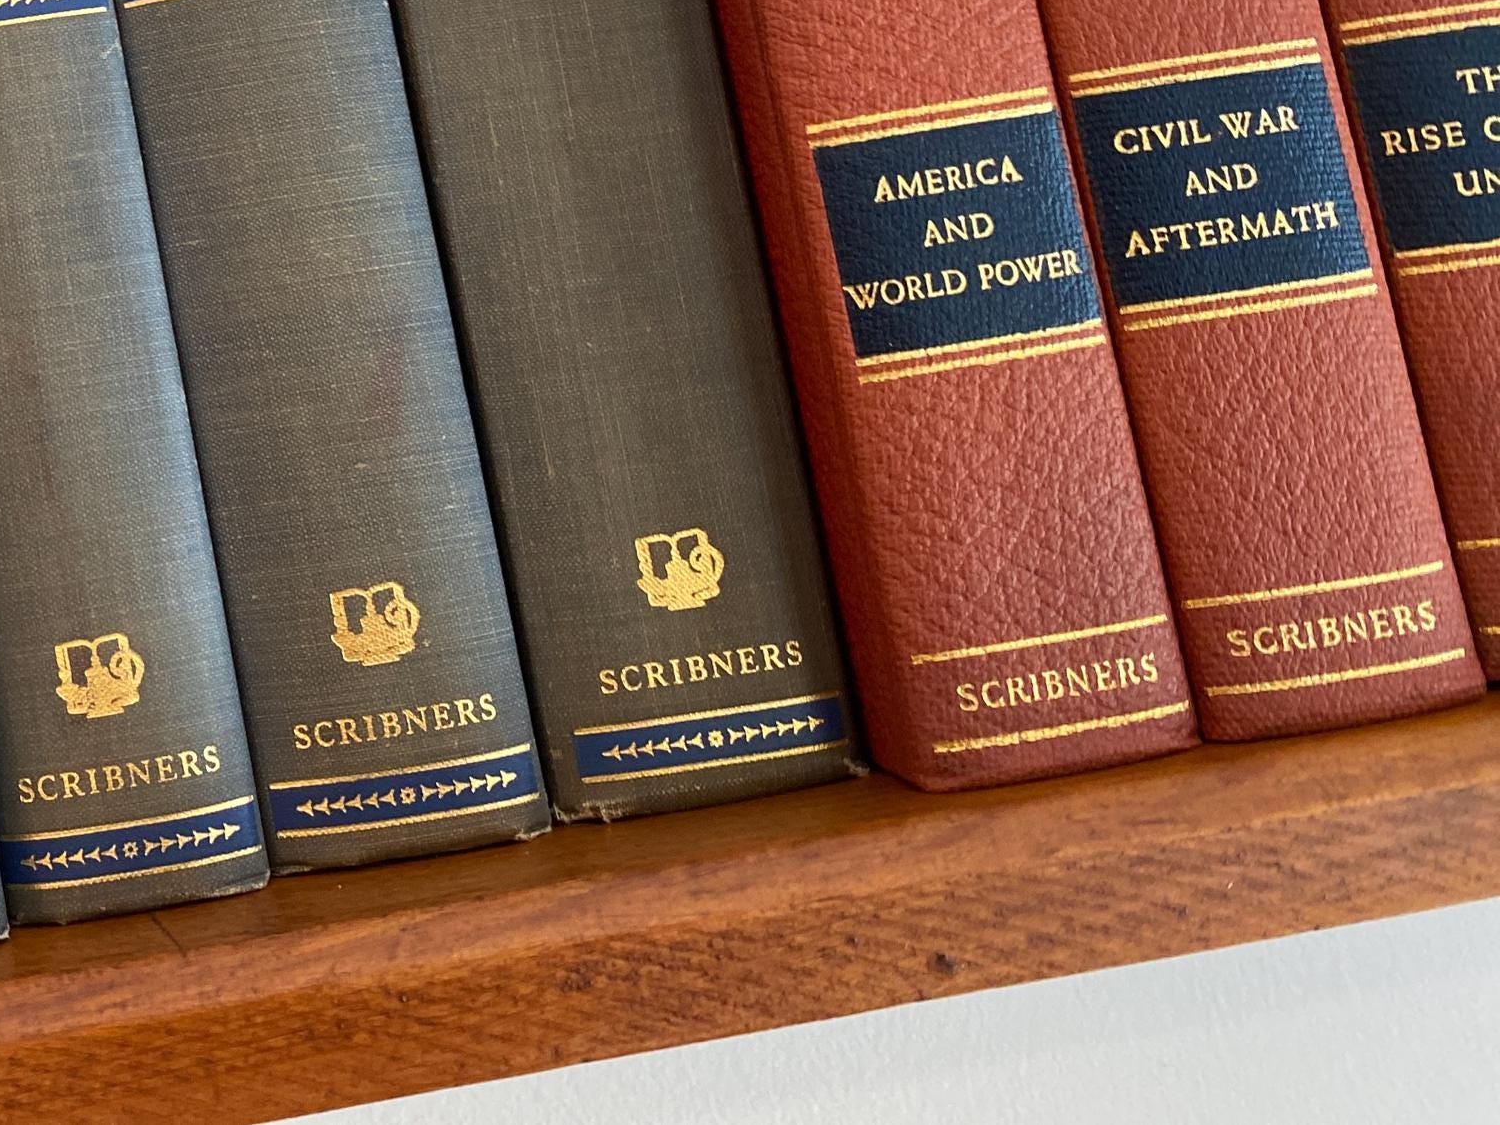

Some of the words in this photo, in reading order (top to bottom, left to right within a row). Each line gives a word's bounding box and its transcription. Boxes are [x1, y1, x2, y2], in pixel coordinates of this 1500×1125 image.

[1113, 118, 1212, 155] CIVIL
[1218, 105, 1300, 139] WAR
[1380, 120, 1467, 156] RISE
[873, 154, 1024, 203] AMERICA
[1185, 163, 1259, 197] AND
[923, 212, 995, 248] AND
[1125, 200, 1341, 259] AFTERMATH
[842, 269, 967, 310] WORLD
[977, 249, 1084, 291] POWER
[1226, 597, 1437, 657] SCRIBNERS
[599, 640, 803, 695] SCRIBNERS
[956, 651, 1159, 712] SCRIBNERS
[293, 692, 497, 750] SCRIBNERS
[18, 744, 221, 803] SCRIBNERS
